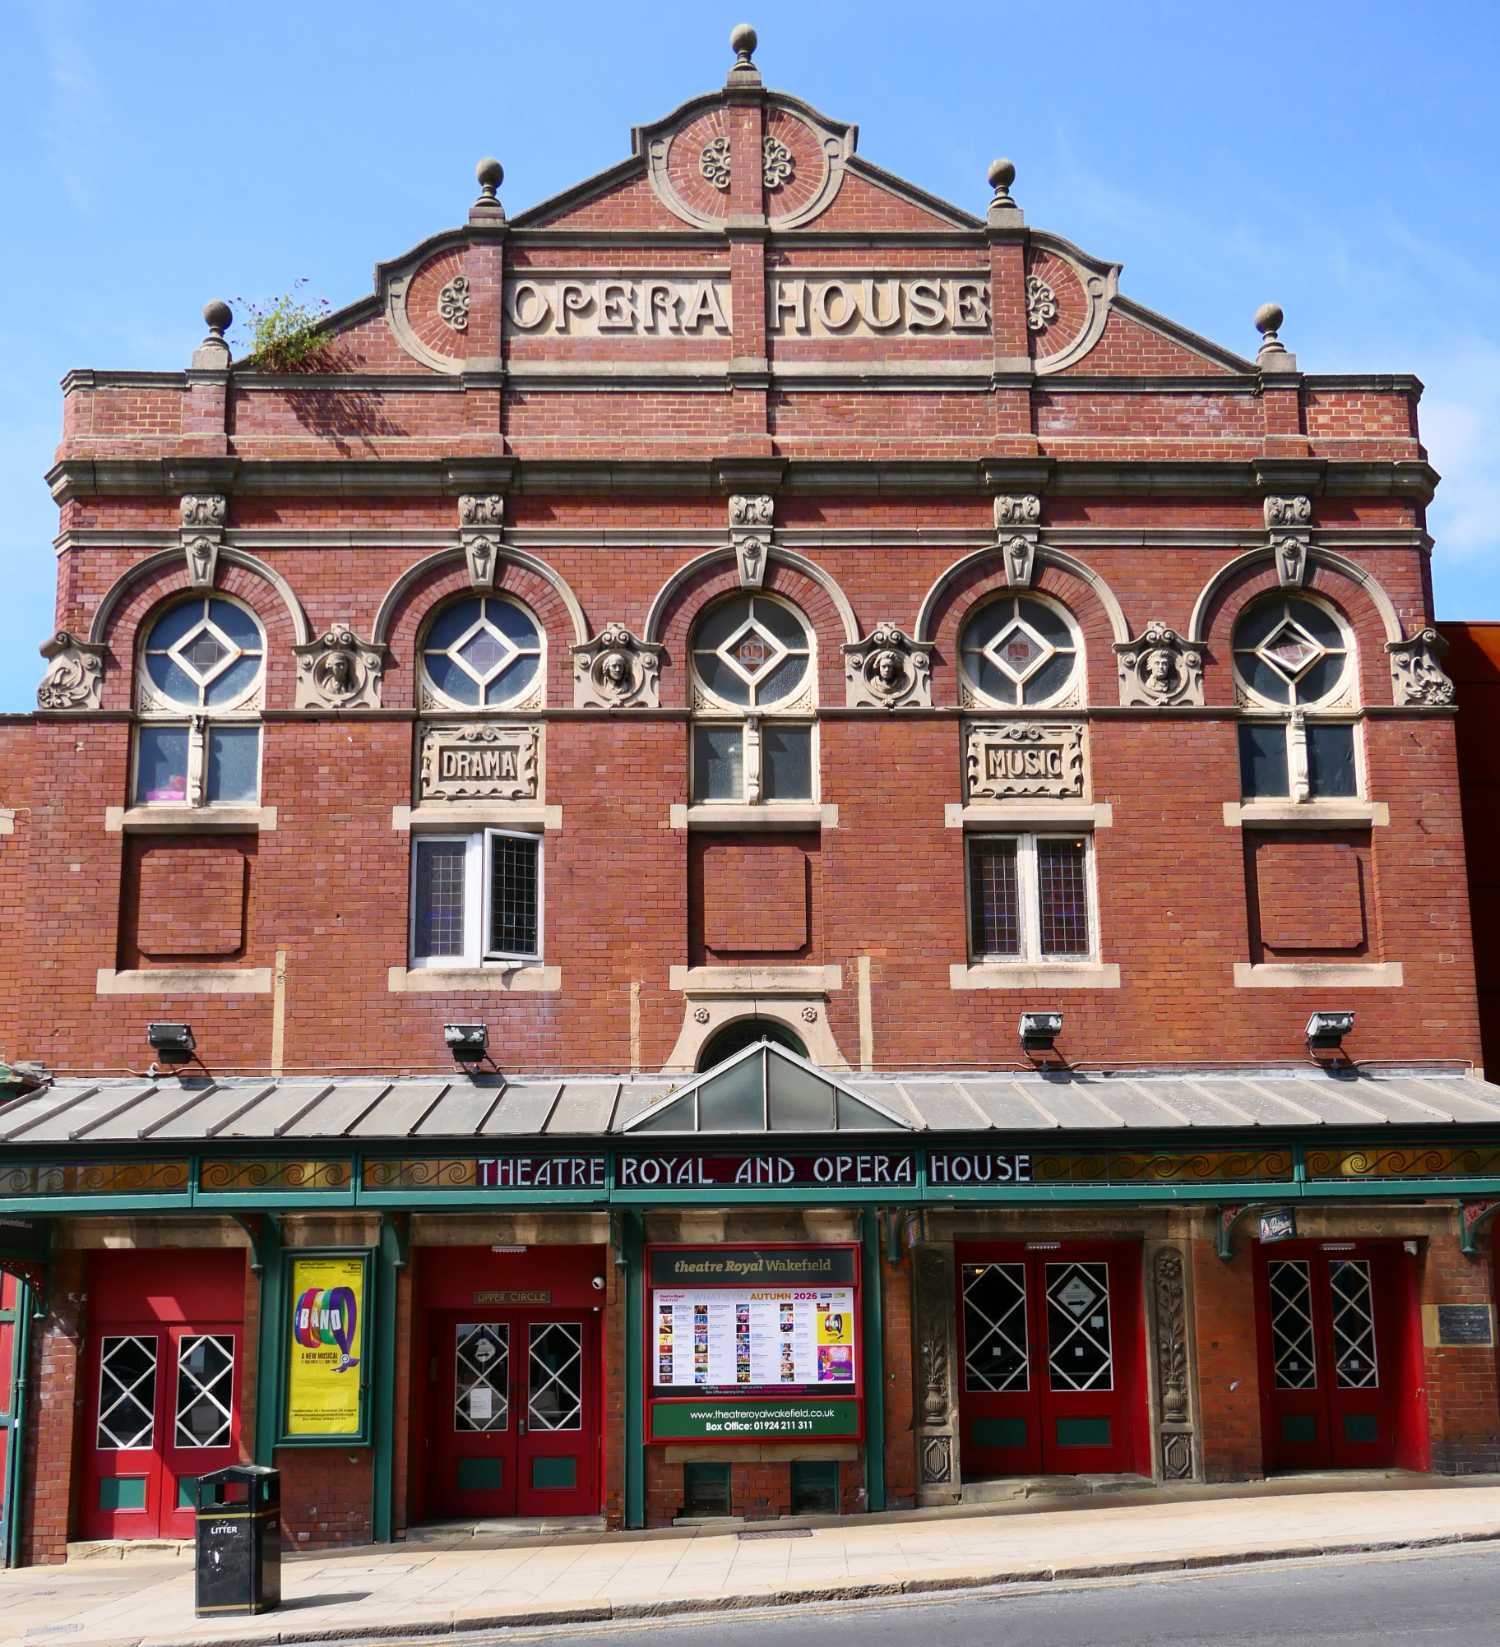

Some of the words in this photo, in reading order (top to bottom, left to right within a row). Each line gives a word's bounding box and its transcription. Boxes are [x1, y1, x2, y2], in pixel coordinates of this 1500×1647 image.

[510, 279, 731, 333] OPERA
[768, 278, 993, 333] HOUSE
[443, 751, 516, 777] DRAMA
[989, 749, 1061, 776] MUSIC
[478, 1158, 604, 1186] THEATRE
[621, 1157, 714, 1185] ROYAL
[735, 1156, 795, 1184] AND
[813, 1156, 911, 1182] OPERA
[931, 1155, 1030, 1182] HOUSE
[674, 1260, 723, 1273] theatre
[725, 1259, 764, 1275] Royal
[766, 1258, 832, 1272] Wakefield
[511, 1292, 545, 1302] CIRCLE
[751, 1292, 791, 1300] AUTUMN
[300, 1308, 341, 1330] BAND
[305, 1352, 317, 1360] NEW
[317, 1352, 339, 1360] MUSICAL
[690, 1408, 835, 1421] www.theatreroyalwakefield.co.uk
[705, 1422, 722, 1431] Box
[724, 1421, 752, 1431] Office:
[754, 1421, 780, 1430] 01924
[781, 1421, 796, 1430] 211
[798, 1420, 813, 1429] 311
[211, 1526, 237, 1534] LITTER
